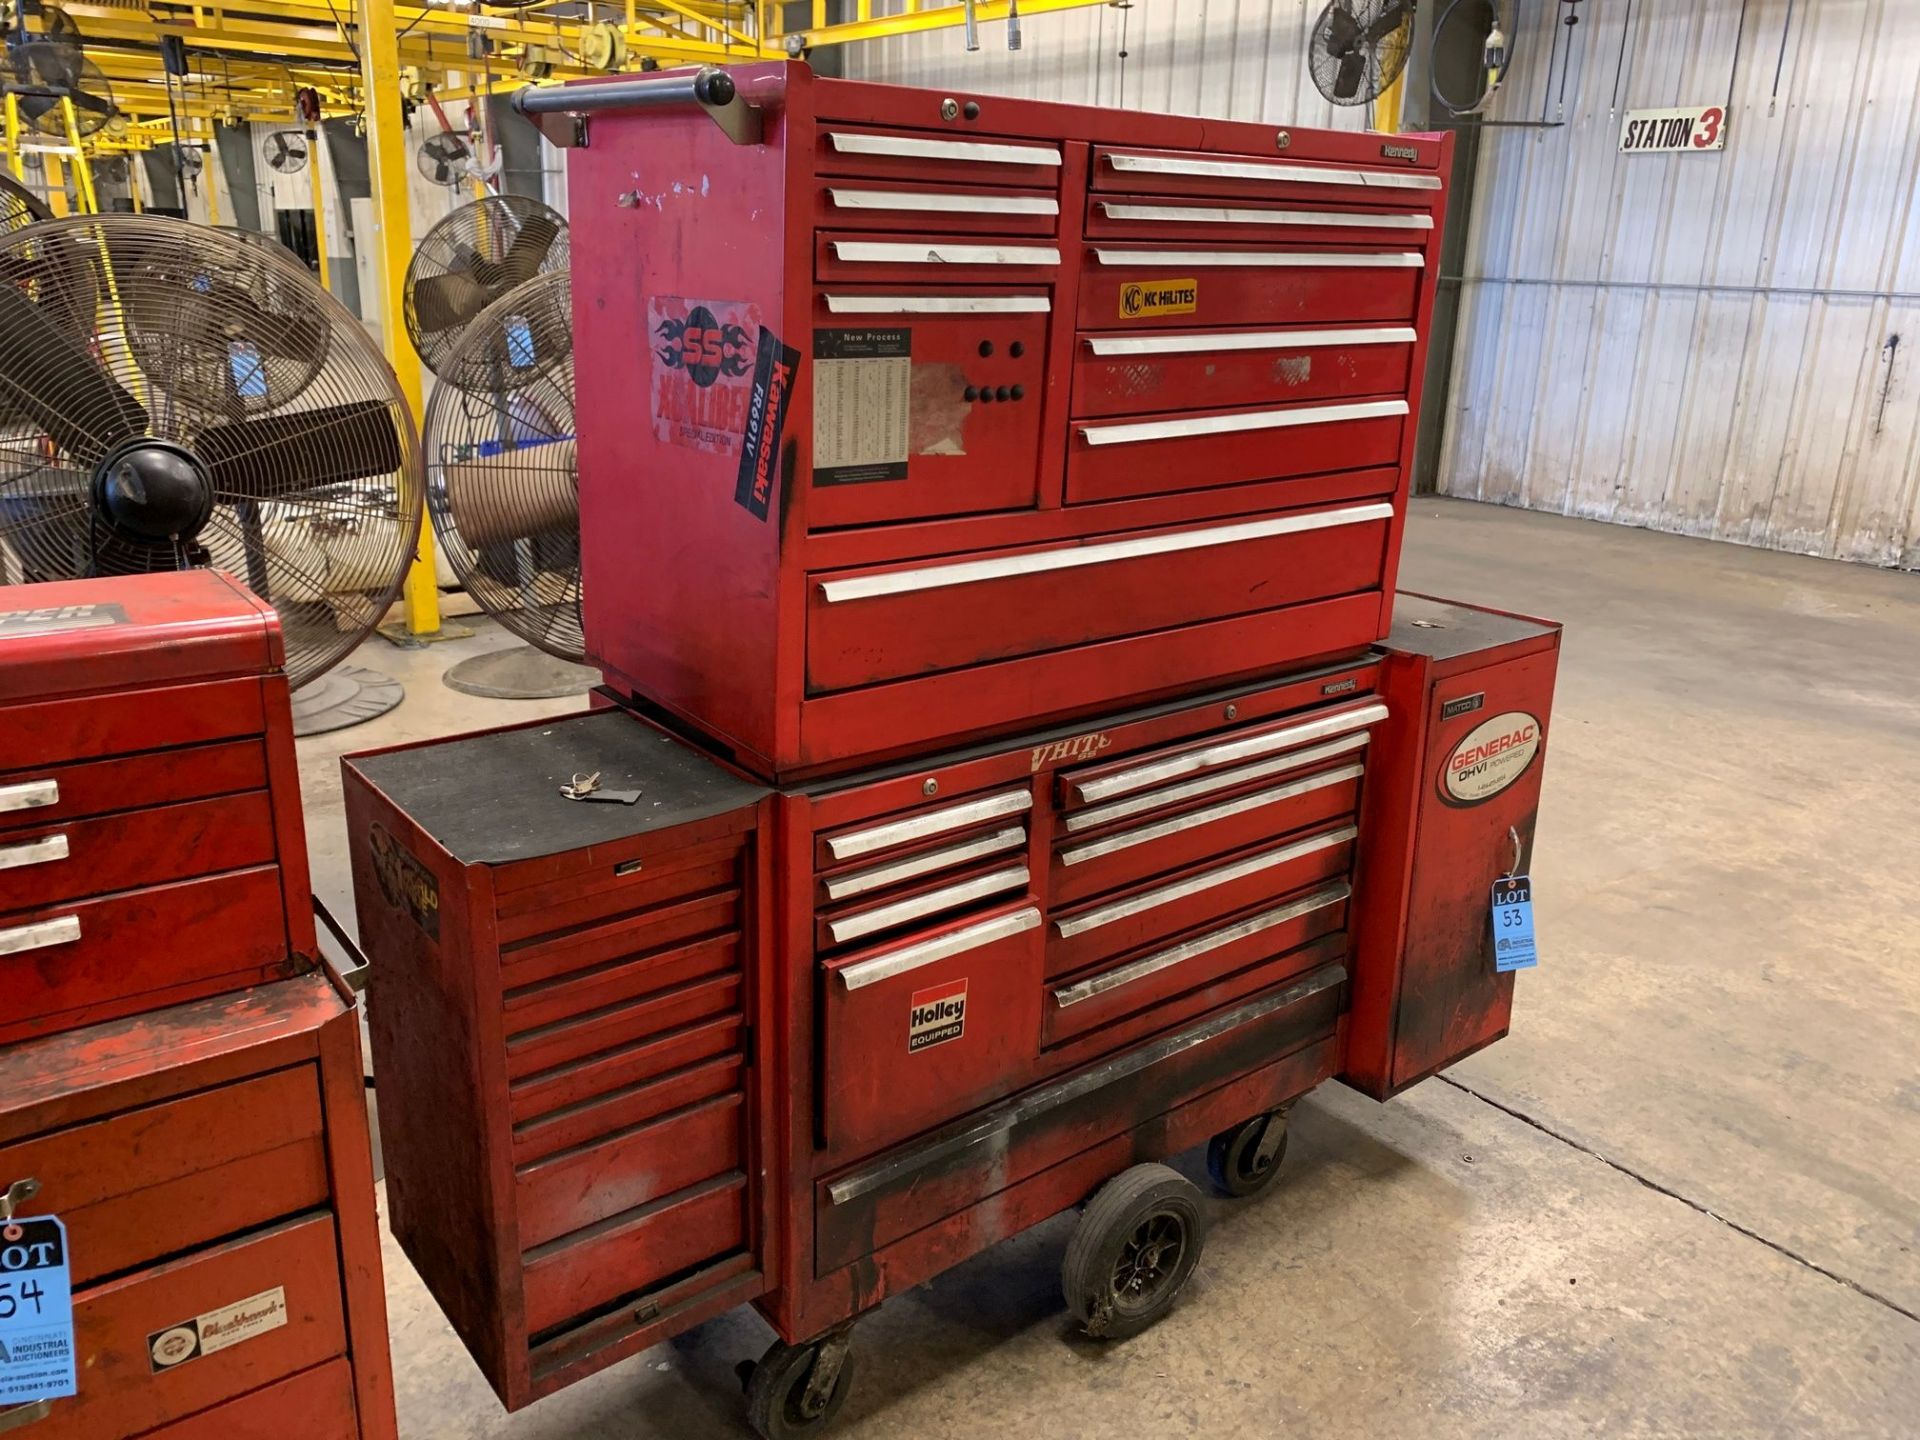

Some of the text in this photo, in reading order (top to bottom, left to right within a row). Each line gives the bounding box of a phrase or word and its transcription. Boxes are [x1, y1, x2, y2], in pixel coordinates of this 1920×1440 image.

[1624, 107, 1723, 149] STATION 3
[1384, 145, 1418, 162] Kennedy
[1125, 287, 1141, 313] KC
[1144, 291, 1157, 307] KC
[681, 327, 723, 367] SS
[843, 333, 901, 341] New Process
[747, 383, 764, 457] FR691V
[753, 360, 791, 504] Kawasaki
[1324, 679, 1356, 694] Kennedy
[1452, 724, 1534, 771] GENERAC
[1458, 749, 1525, 782] OHVI POWERED
[1497, 889, 1527, 905] LOT
[1503, 908, 1523, 928] 53
[911, 1000, 965, 1028] Holley
[911, 1025, 960, 1047] EQUIPPED
[0, 1279, 44, 1318] 54
[201, 1300, 278, 1340] Blackhawk
[12, 1339, 69, 1354] INDUSTRIAL
[12, 1348, 70, 1362] AUCTIONEERS
